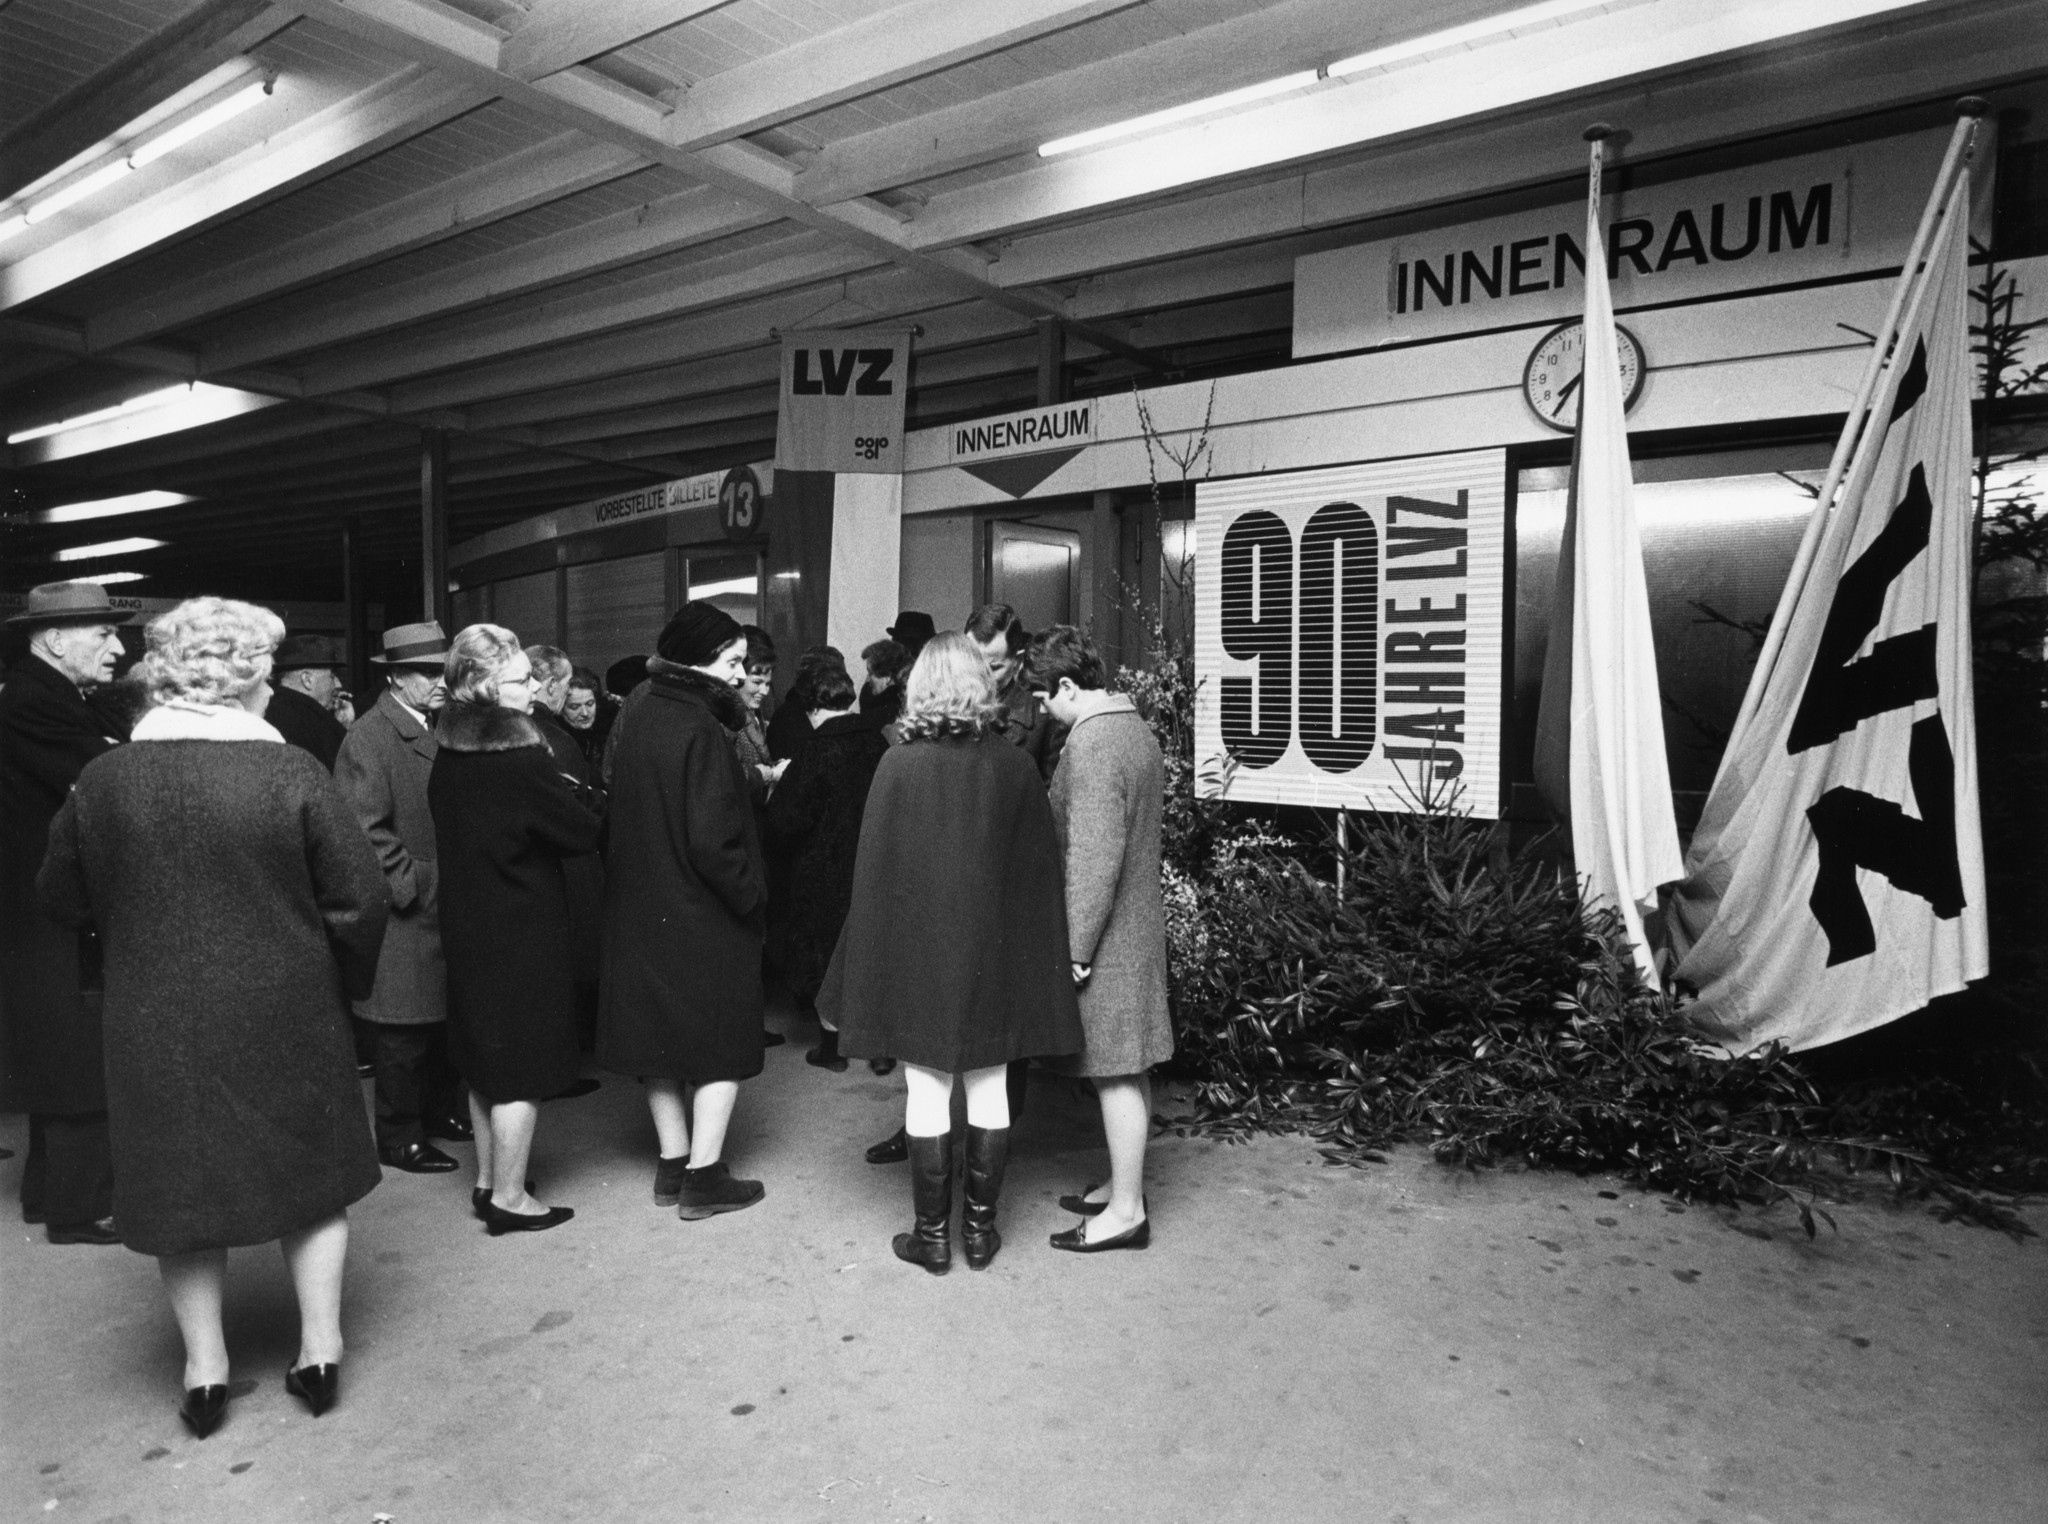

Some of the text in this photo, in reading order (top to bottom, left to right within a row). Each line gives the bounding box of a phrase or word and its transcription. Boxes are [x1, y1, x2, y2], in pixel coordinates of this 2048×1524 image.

[1397, 183, 1832, 314] INNENRAUM
[1547, 354, 1558, 366] 10
[1562, 339, 1572, 351] 11
[792, 348, 894, 396] LVZ
[1539, 373, 1547, 385] 9
[1543, 390, 1551, 401] 8
[956, 407, 1090, 455] INNENRAUM
[595, 480, 717, 522] VORBESTELLTE BILLETE
[722, 481, 754, 527] 13
[1220, 500, 1379, 774] 90
[1384, 488, 1469, 781] JAHRE LVZ
